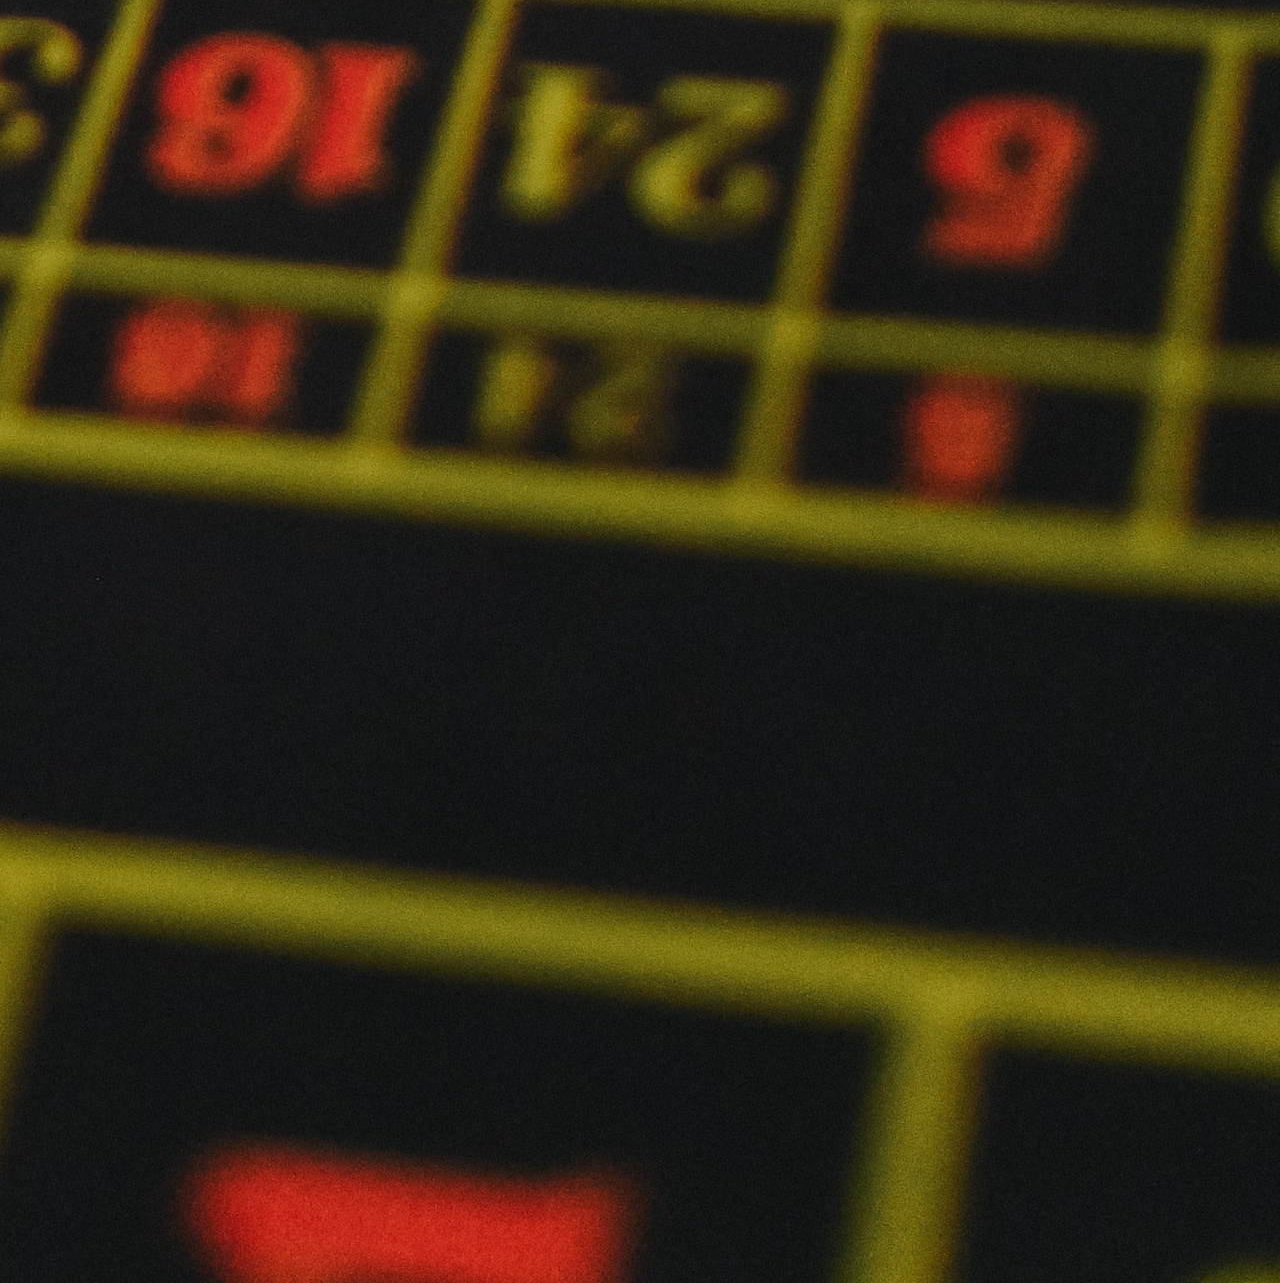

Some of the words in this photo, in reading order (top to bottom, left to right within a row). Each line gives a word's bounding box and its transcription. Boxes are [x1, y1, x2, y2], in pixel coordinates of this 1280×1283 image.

[145, 28, 422, 204] 16
[499, 60, 791, 232] 24
[923, 90, 1098, 271] 5
